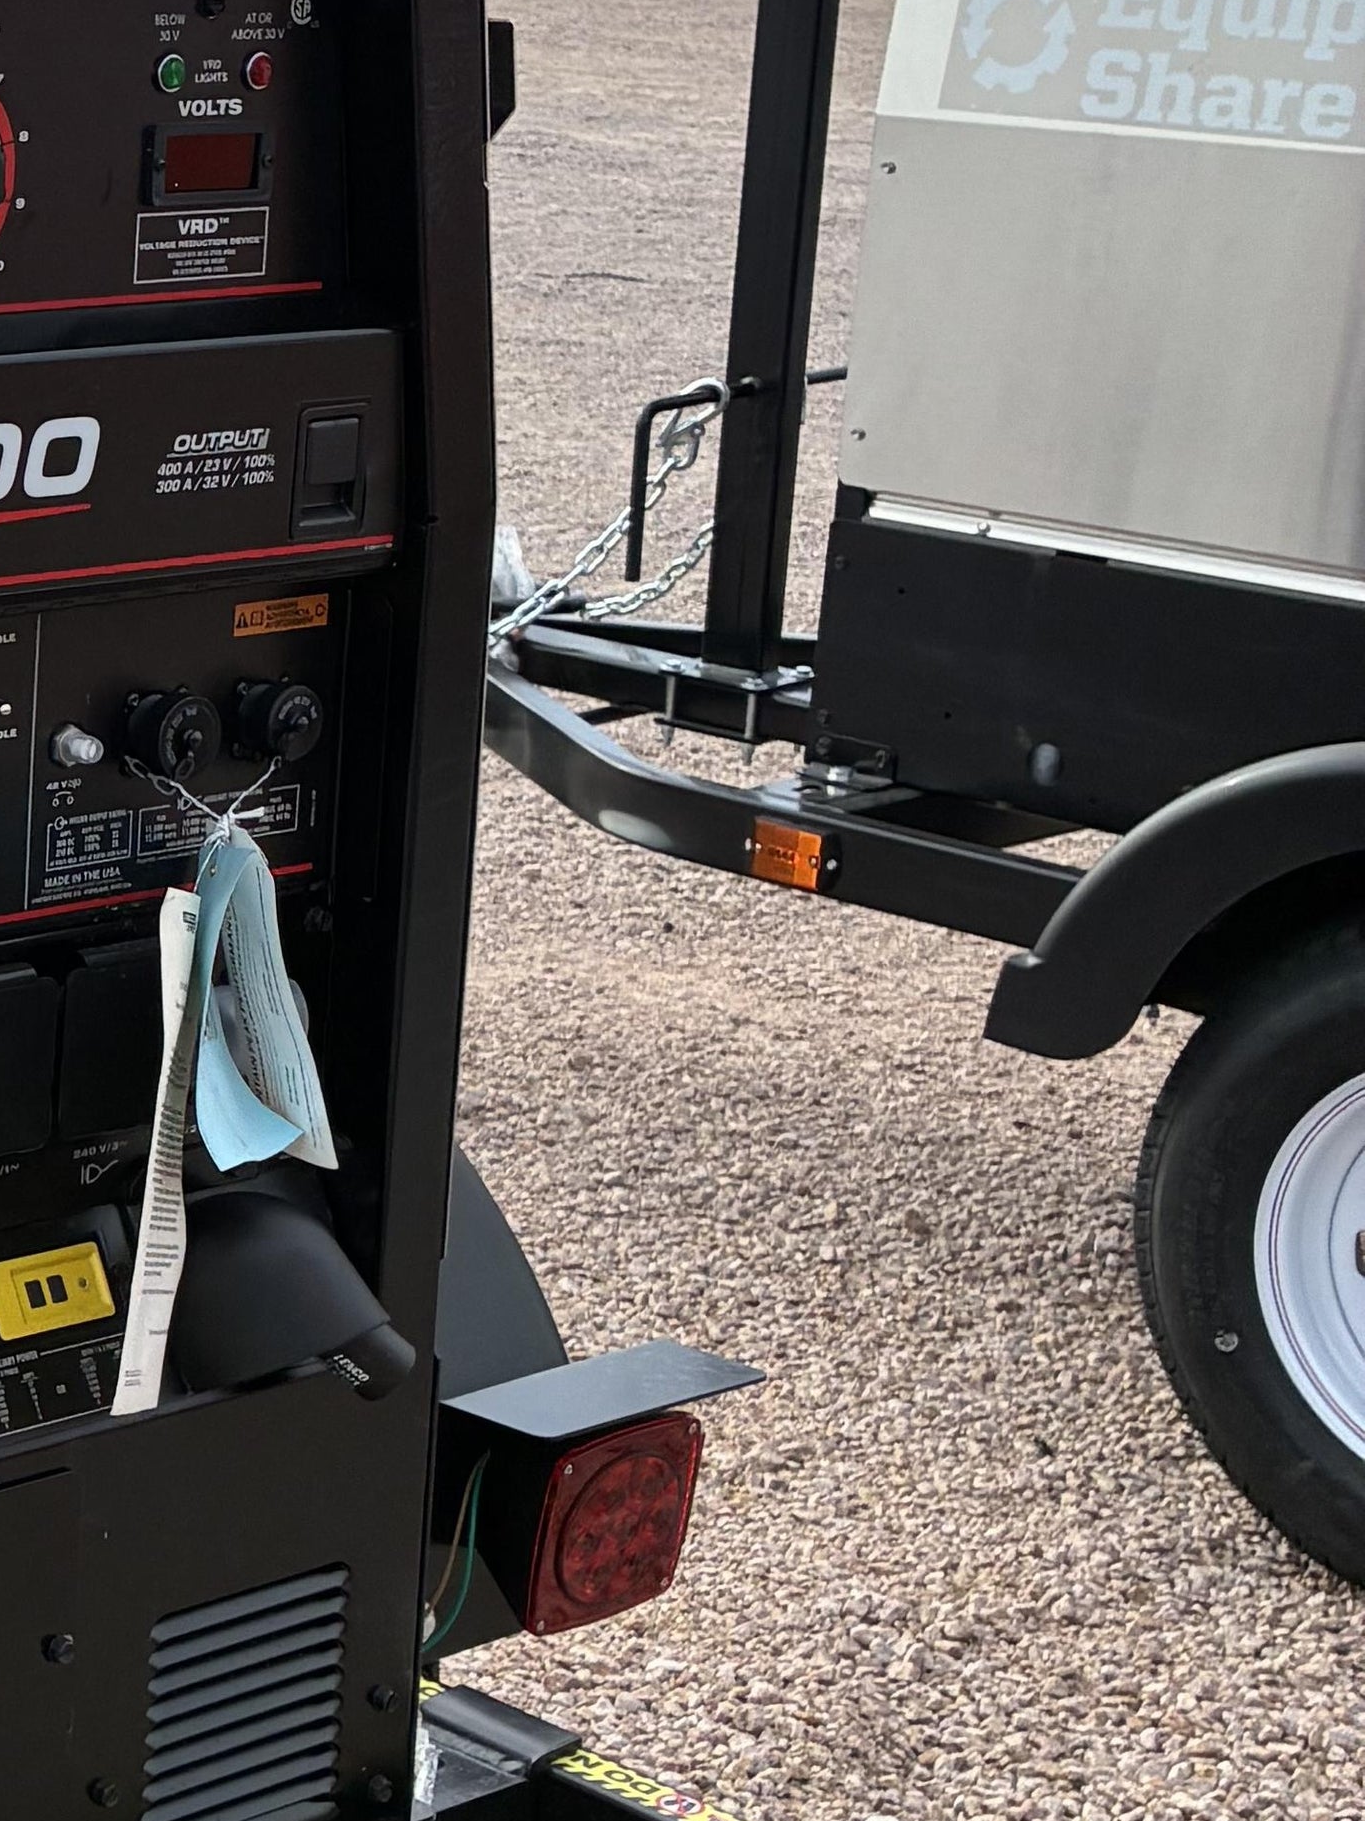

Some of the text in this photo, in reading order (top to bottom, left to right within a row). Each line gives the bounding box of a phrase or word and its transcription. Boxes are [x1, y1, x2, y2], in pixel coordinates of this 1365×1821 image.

[155, 14, 186, 26] BELOW
[1080, 49, 1357, 139] Share
[178, 98, 243, 117] VOLTS
[19, 131, 29, 142] 8
[16, 198, 25, 210] 9
[173, 429, 267, 454] OUTPUT
[157, 462, 182, 476] 400
[156, 480, 181, 493] 300
[243, 470, 274, 484] 100%
[44, 874, 70, 888] MADE
[84, 869, 101, 881] THE
[73, 1147, 97, 1160] 240
